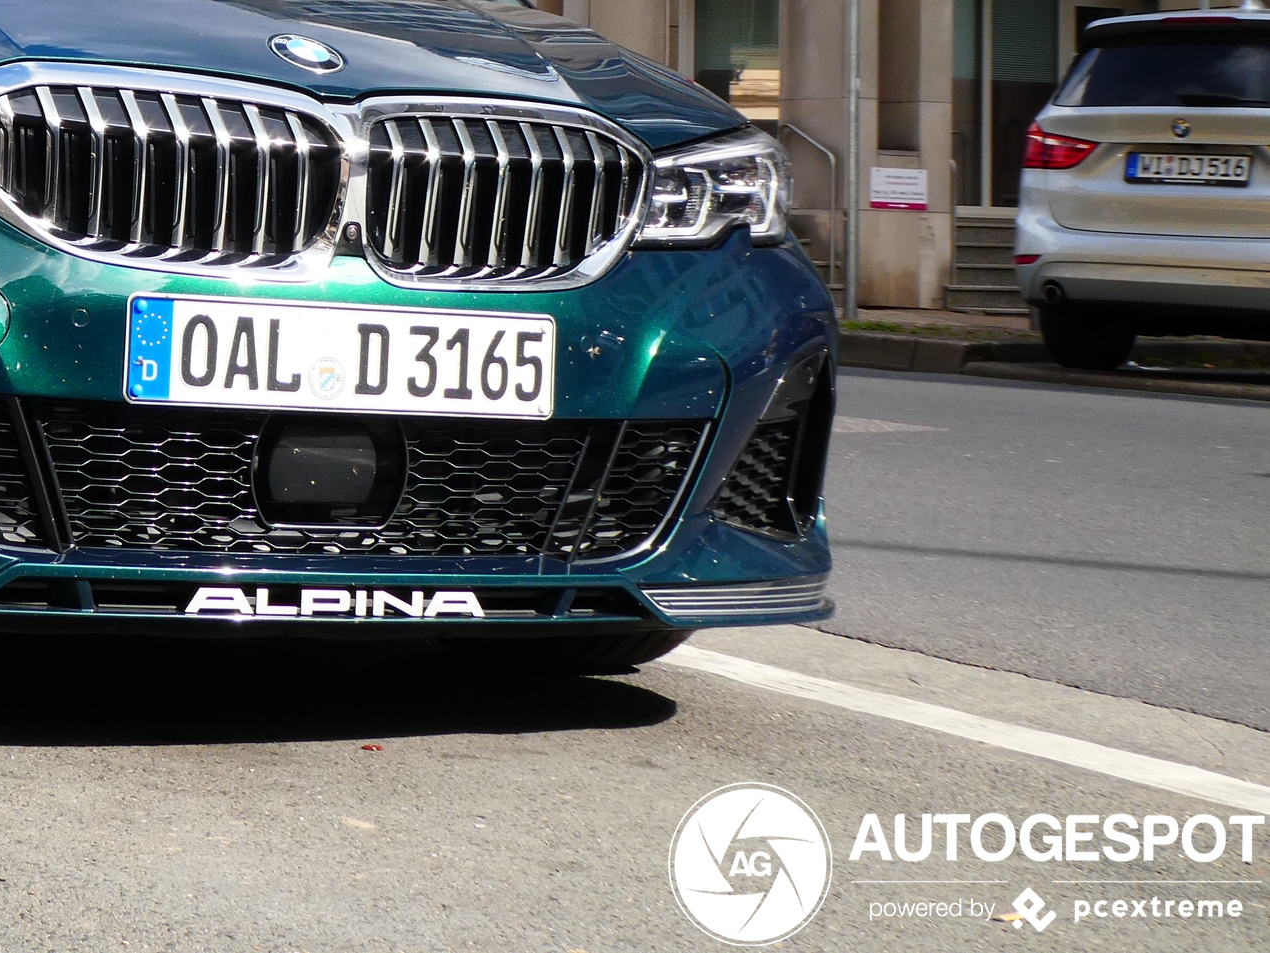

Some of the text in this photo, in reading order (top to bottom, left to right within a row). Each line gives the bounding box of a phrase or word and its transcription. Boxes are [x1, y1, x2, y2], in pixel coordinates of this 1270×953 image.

[141, 361, 158, 381] D
[180, 313, 301, 392] OAL
[354, 323, 390, 395] D
[407, 325, 544, 402] 3165
[184, 587, 485, 617] ALPINA
